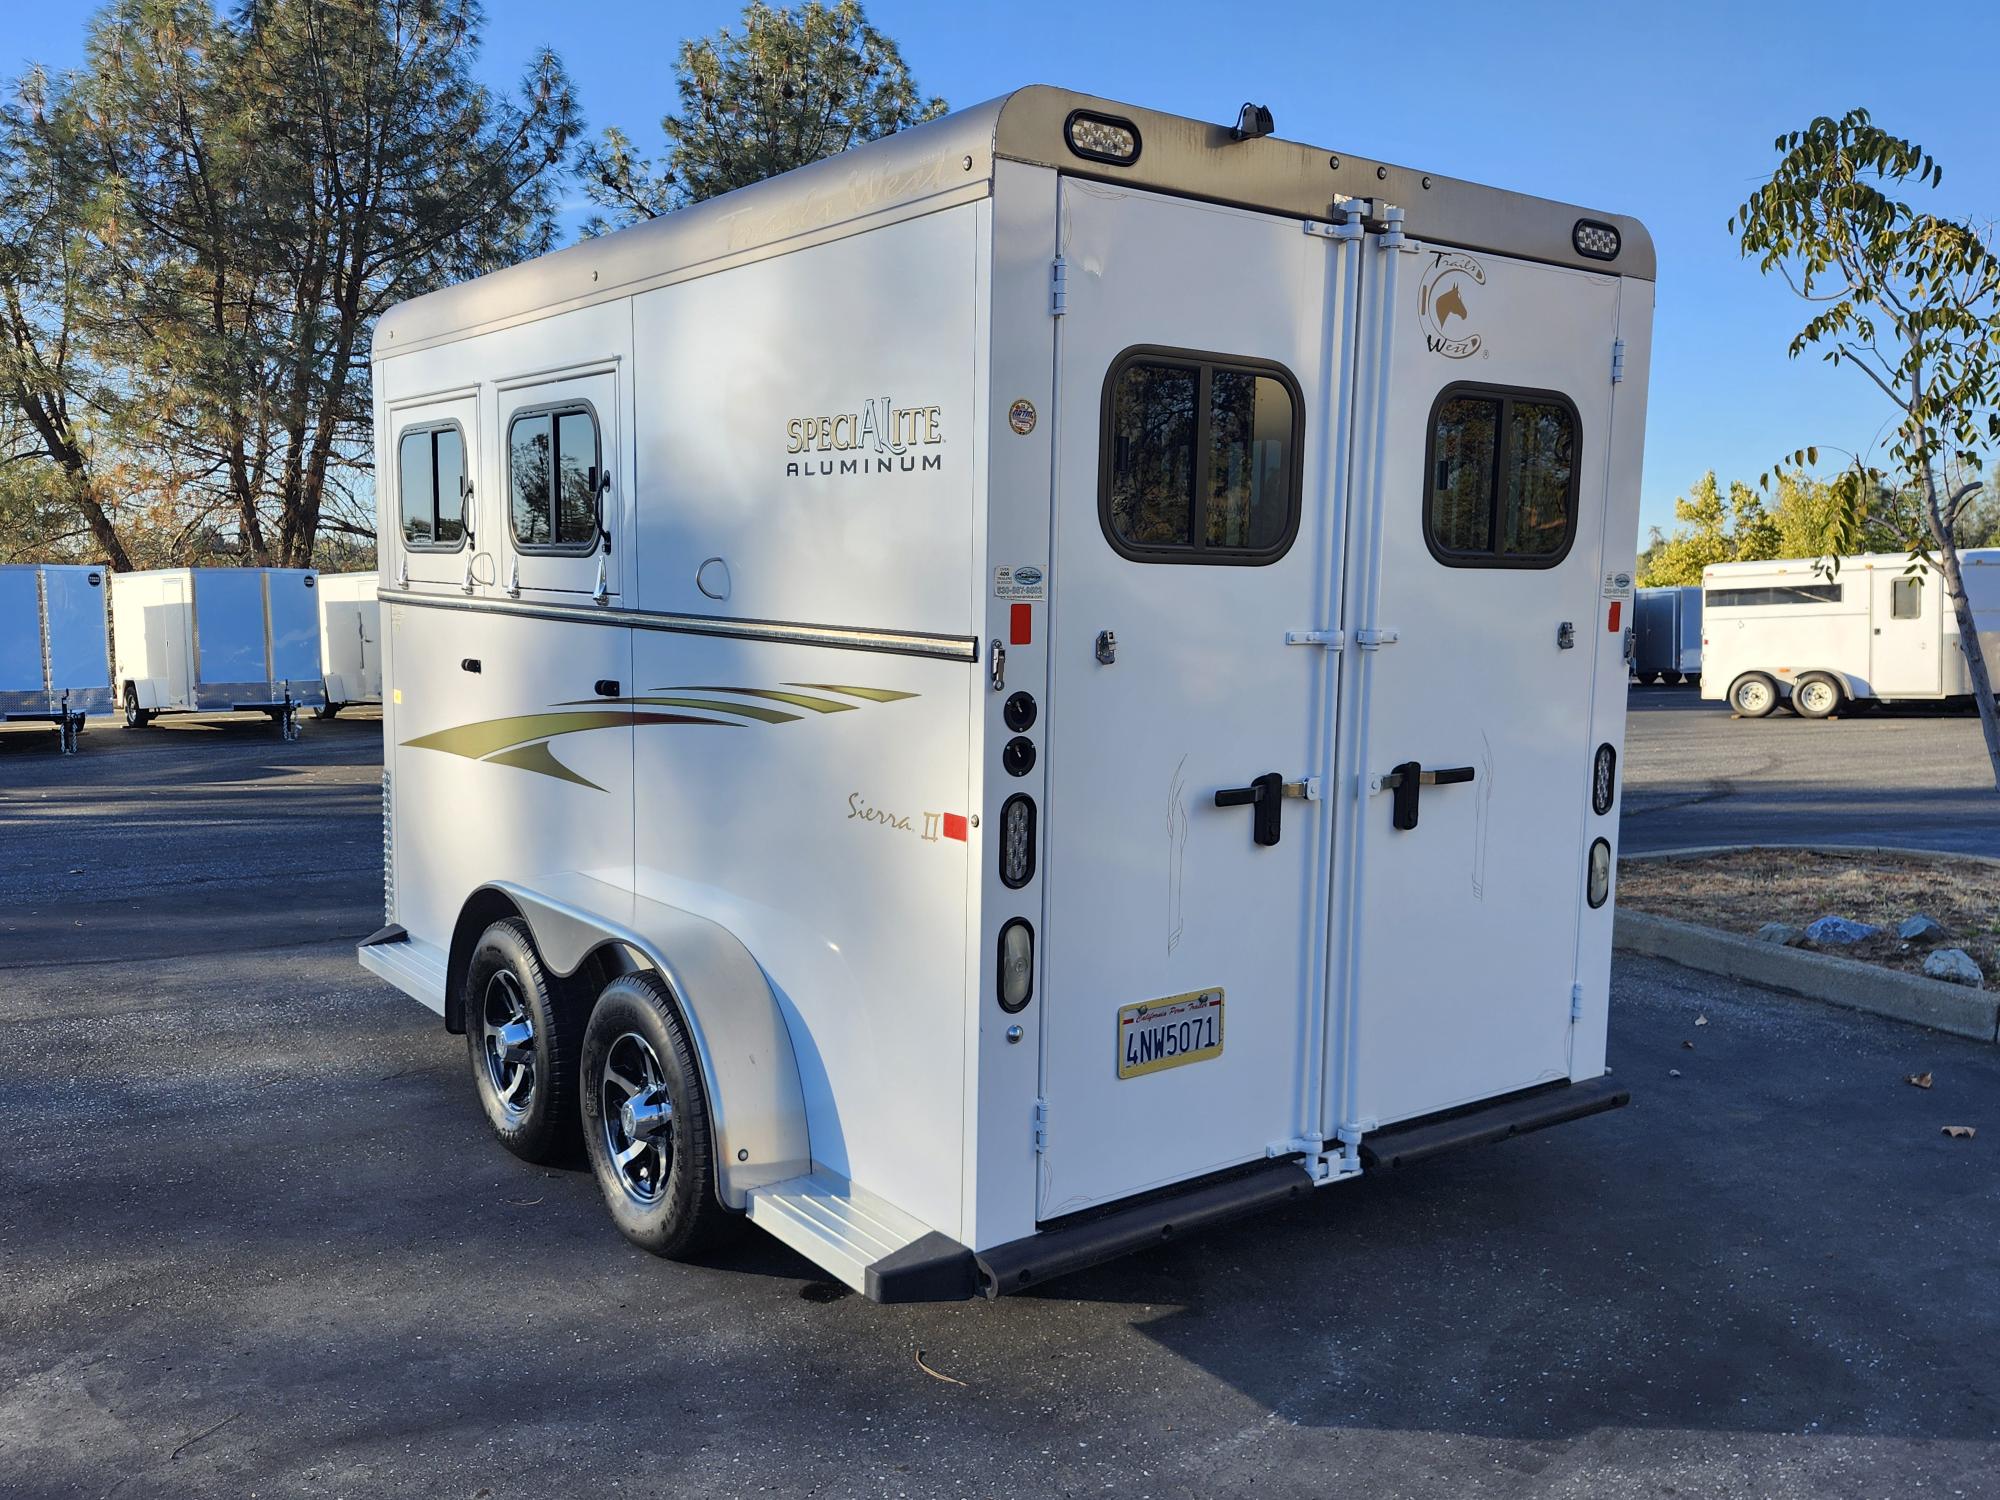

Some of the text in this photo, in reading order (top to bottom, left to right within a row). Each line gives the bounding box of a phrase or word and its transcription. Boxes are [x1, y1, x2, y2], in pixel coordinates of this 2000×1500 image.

[1429, 250, 1477, 272] Trails
[1427, 334, 1469, 354] West
[787, 397, 942, 455] SPECIALITE
[787, 455, 942, 477] ALUMINUM
[848, 792, 941, 842] Sierra II
[1136, 1010, 1167, 1024] California
[1126, 1016, 1216, 1065] 4NW5071
